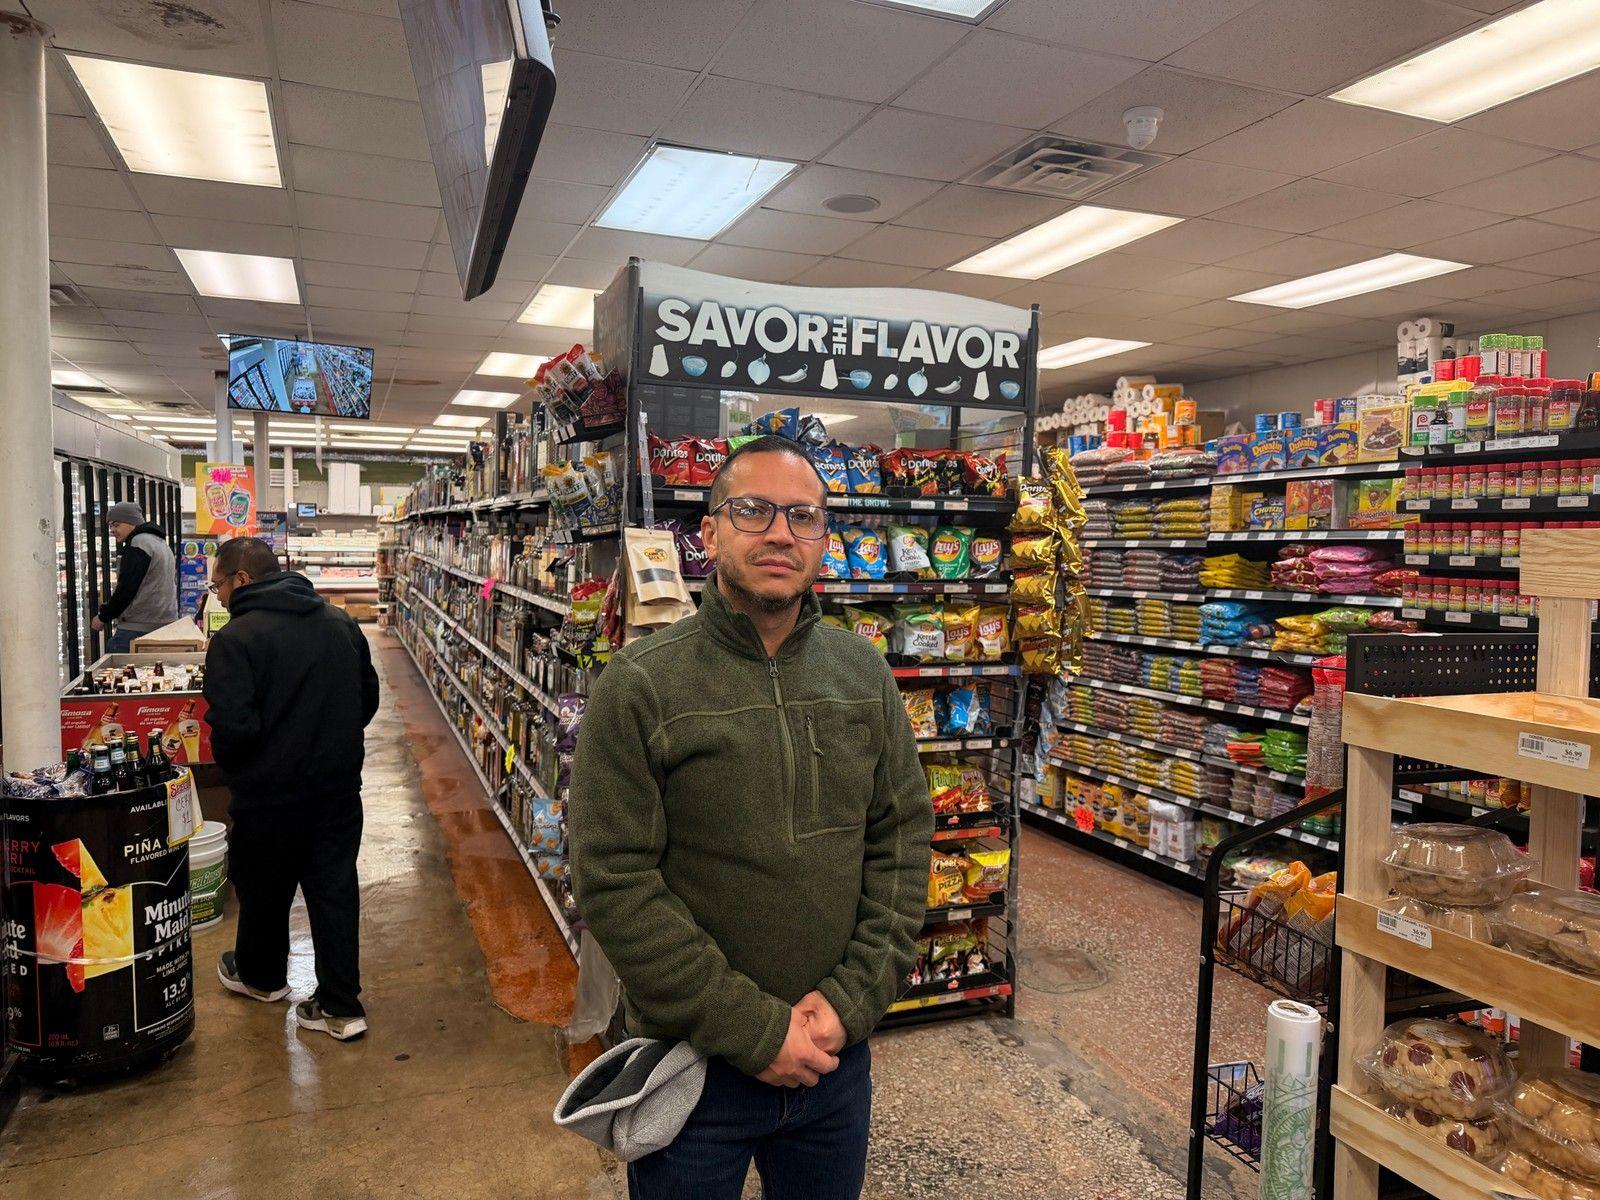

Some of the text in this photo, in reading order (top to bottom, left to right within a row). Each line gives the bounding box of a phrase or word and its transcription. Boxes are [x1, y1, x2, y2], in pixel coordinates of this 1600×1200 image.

[655, 298, 1021, 369] SAVOR THE FLAVOR
[653, 448, 689, 459] Doritos
[696, 452, 727, 463] Dorito
[946, 625, 969, 640] Lay's
[979, 620, 1001, 635] Lay's
[913, 640, 939, 648] Cooked
[915, 633, 937, 641] Kettle
[124, 838, 162, 858] PIÑA
[130, 849, 168, 865] FLAVORED
[938, 878, 962, 891] PIZZA
[154, 911, 190, 944] Maid
[145, 932, 191, 961] SPIKE
